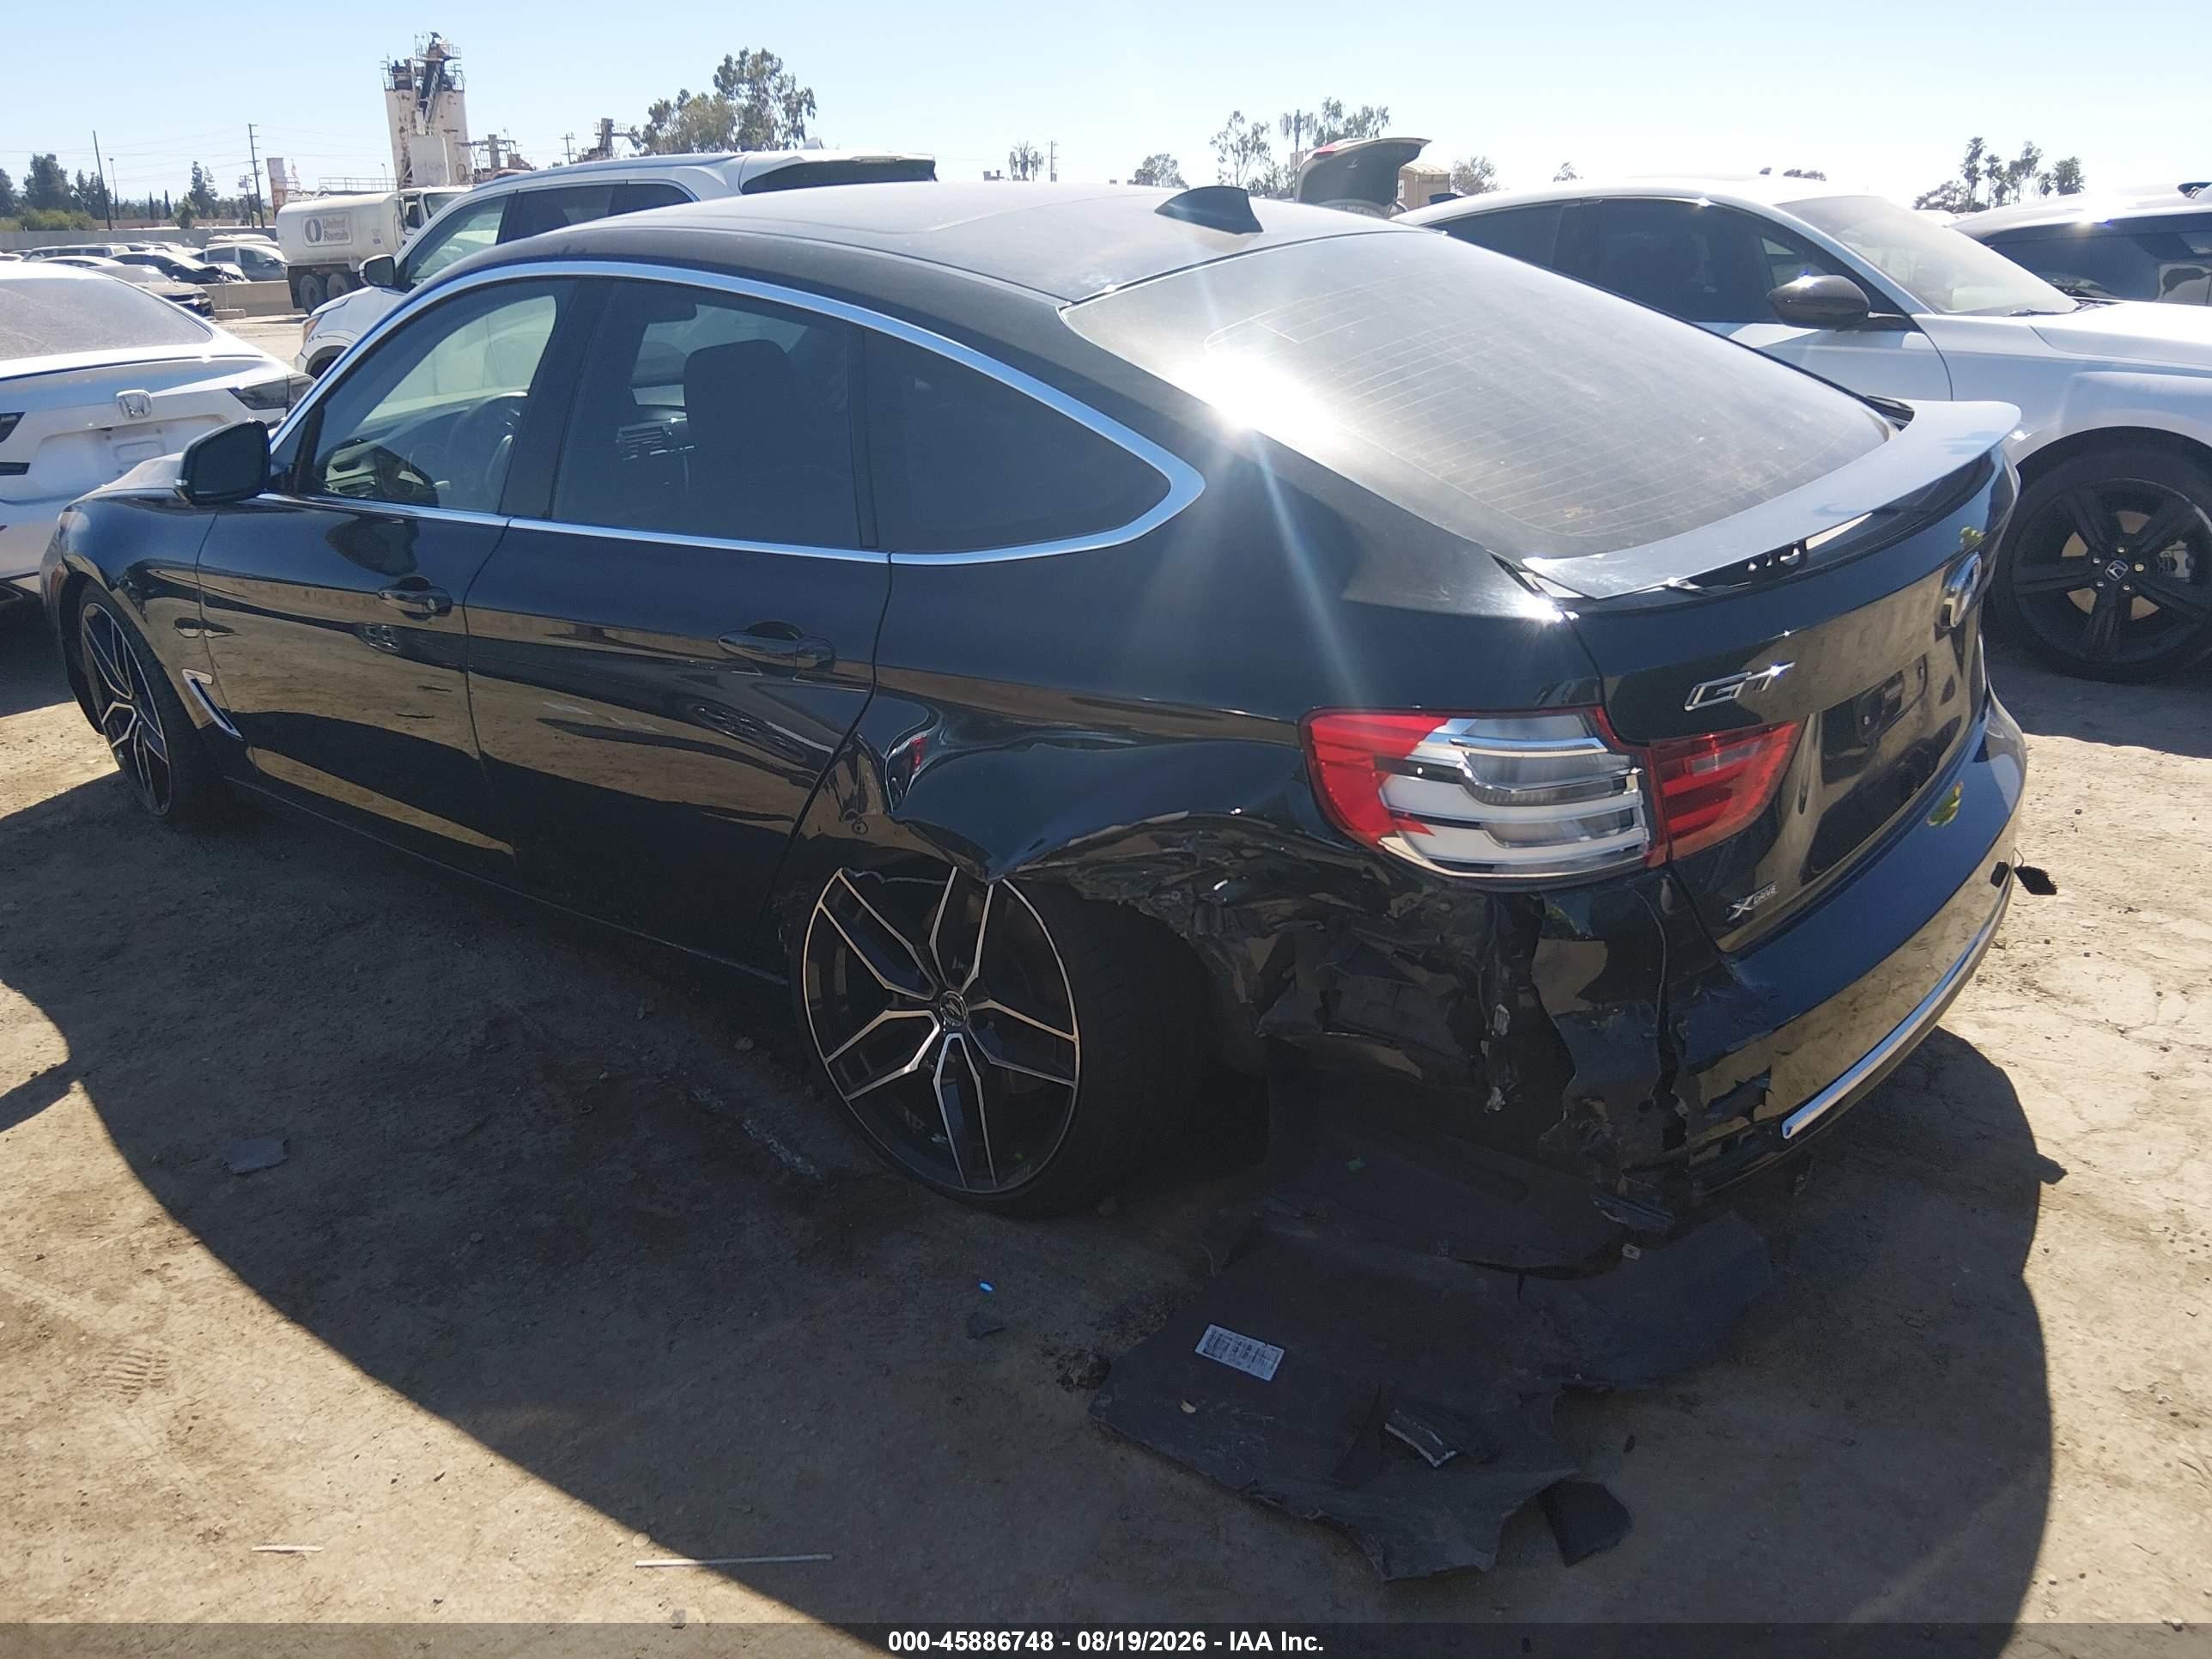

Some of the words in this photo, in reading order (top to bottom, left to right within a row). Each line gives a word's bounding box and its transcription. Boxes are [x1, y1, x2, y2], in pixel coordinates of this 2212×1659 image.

[322, 216, 345, 229] United
[323, 228, 349, 241] Rentals
[1685, 662, 1796, 712] GT
